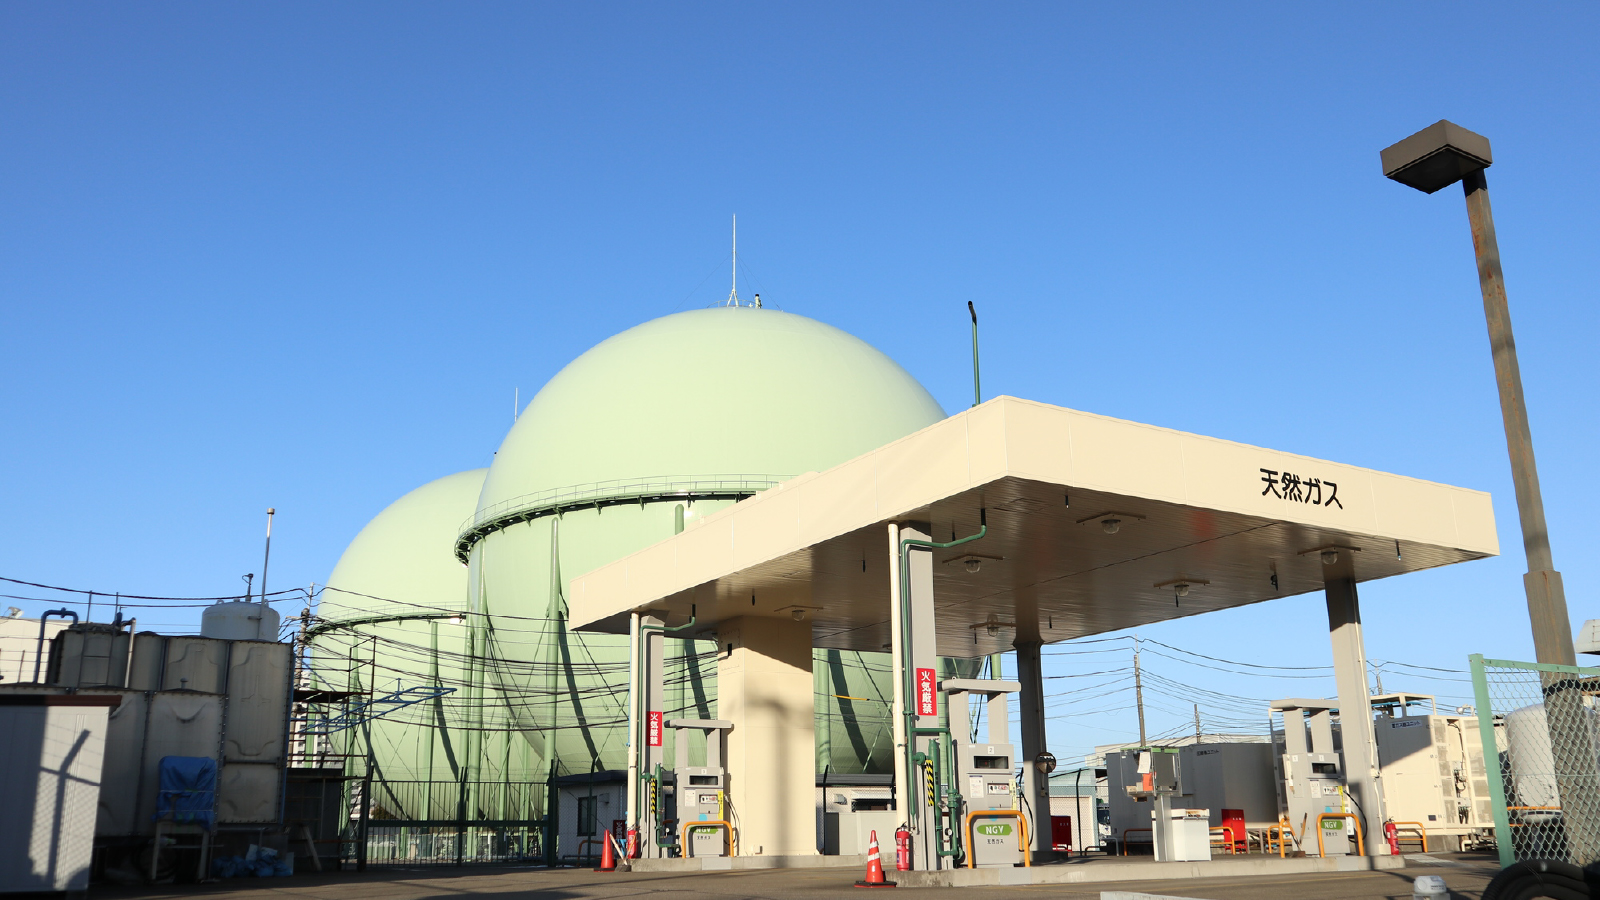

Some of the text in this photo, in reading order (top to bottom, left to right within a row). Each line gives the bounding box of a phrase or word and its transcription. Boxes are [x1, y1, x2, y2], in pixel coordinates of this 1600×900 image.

[1260, 468, 1343, 510] 天然ガス
[921, 670, 932, 714] 火気厳禁
[650, 712, 659, 745] 火気厳禁
[985, 825, 1004, 835] NGV
